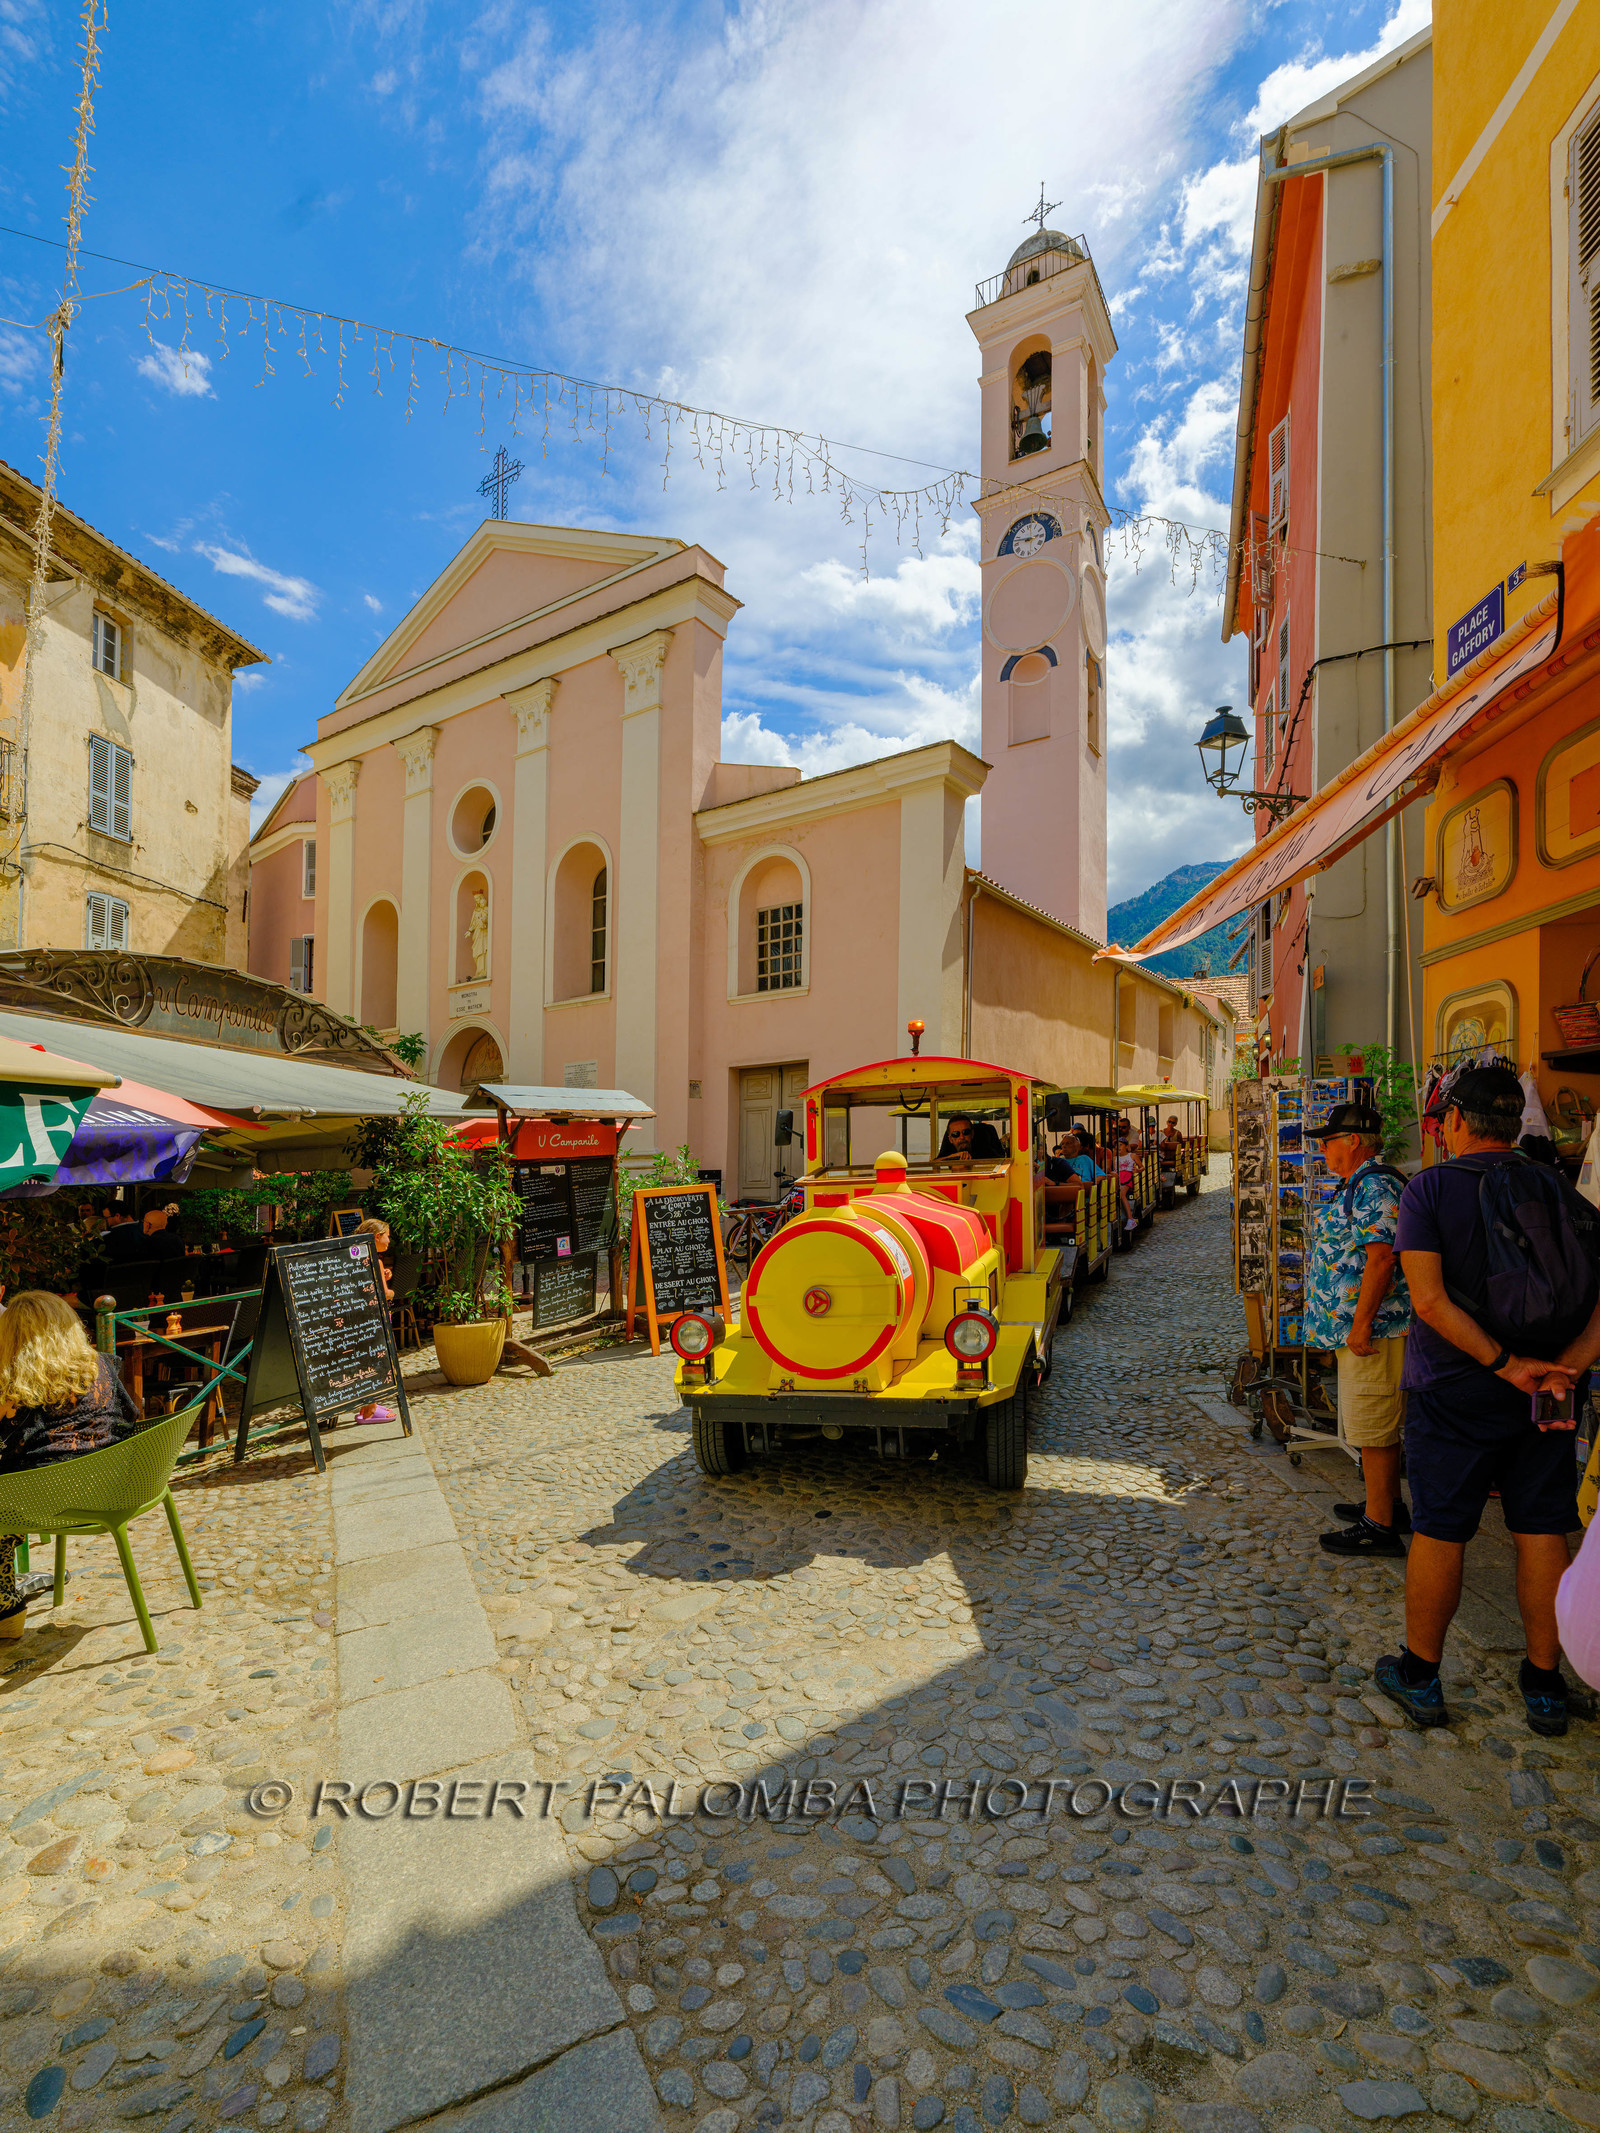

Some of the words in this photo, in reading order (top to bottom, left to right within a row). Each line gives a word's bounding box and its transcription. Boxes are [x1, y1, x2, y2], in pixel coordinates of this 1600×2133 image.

[1513, 570, 1520, 585] 3
[1458, 604, 1488, 642] PLACE
[1452, 620, 1495, 667] GAFFORY
[174, 974, 275, 1039] Campanile
[538, 1134, 546, 1148] U
[549, 1133, 600, 1150] Campanile
[655, 1197, 663, 1205] LA
[649, 1219, 676, 1229] ENTRÉE
[656, 1247, 672, 1255] PLAT
[655, 1280, 684, 1290] DESSERT
